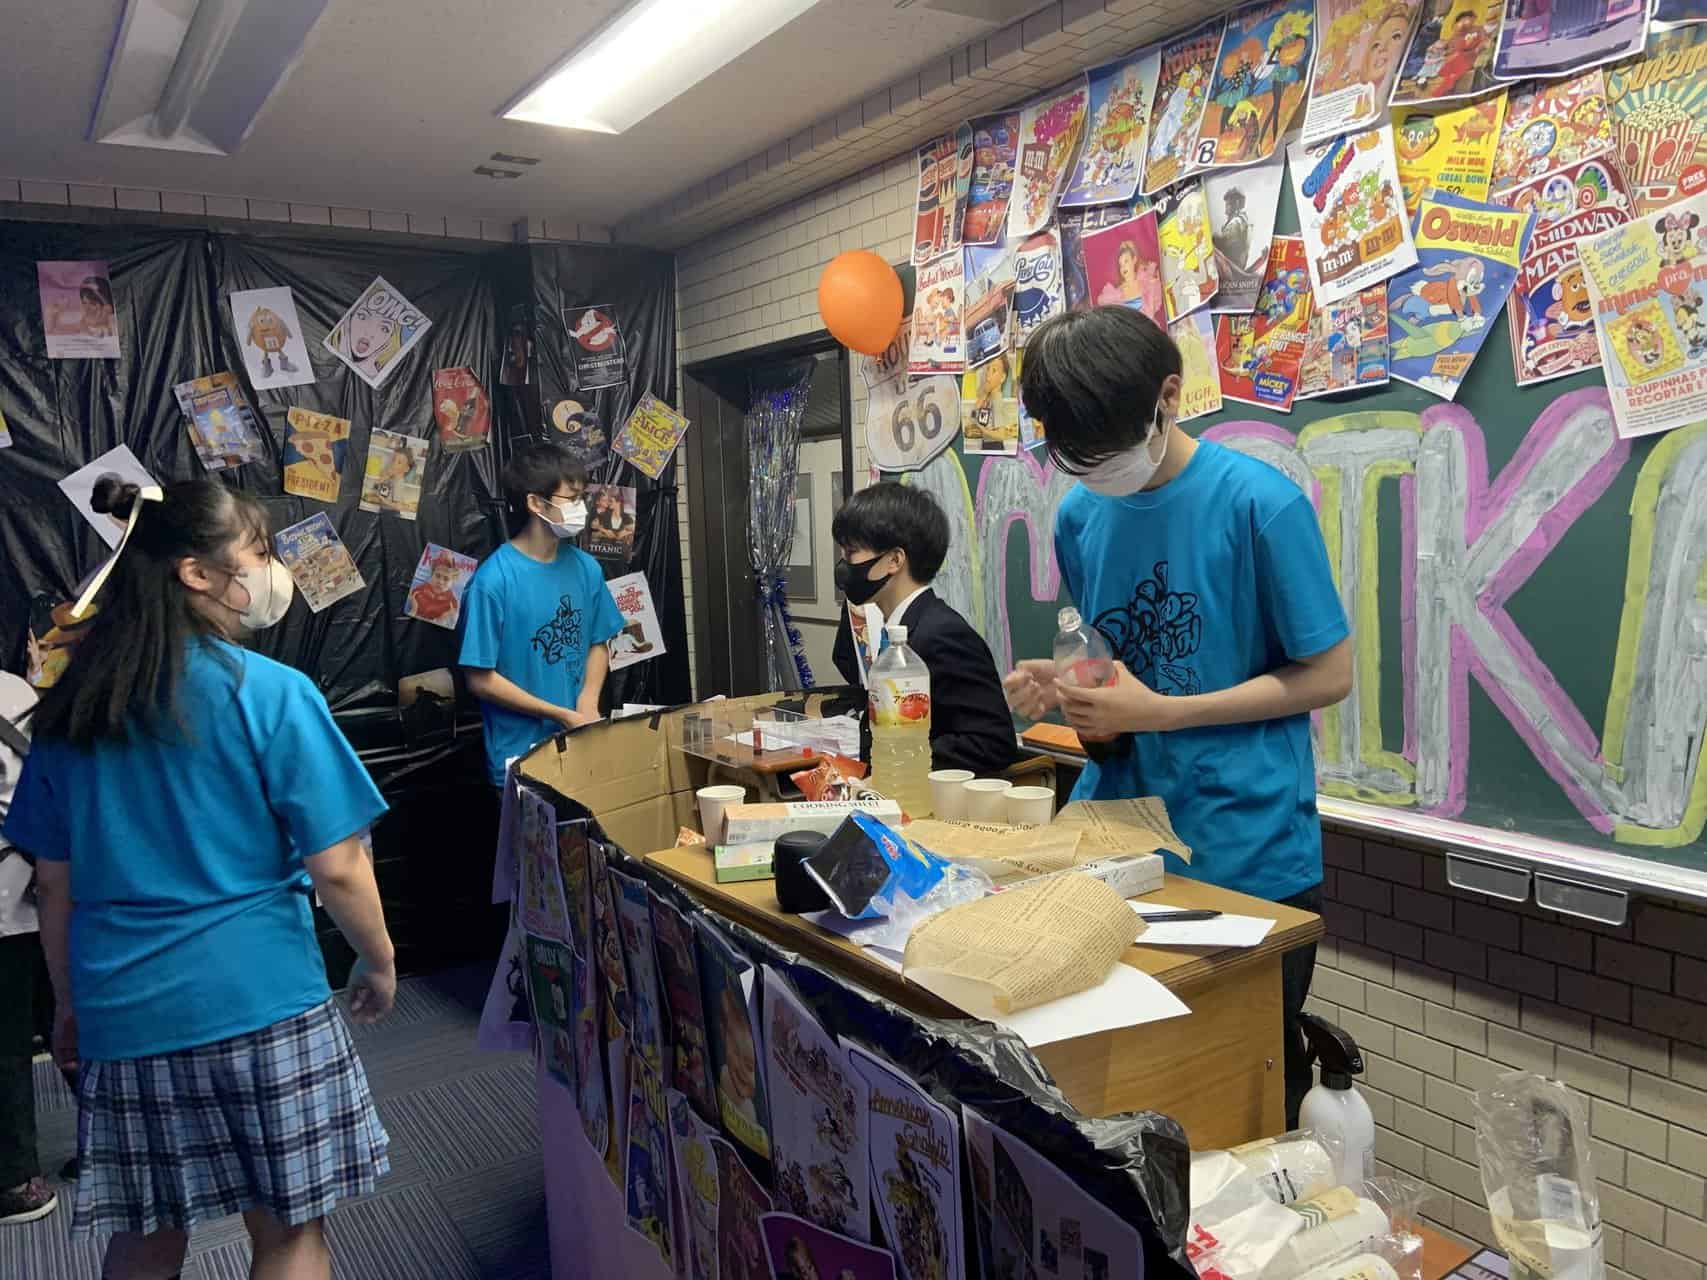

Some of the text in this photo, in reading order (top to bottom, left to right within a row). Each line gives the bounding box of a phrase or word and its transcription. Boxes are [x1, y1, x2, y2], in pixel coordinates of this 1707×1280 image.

[1603, 44, 1707, 104] Cinem
[1422, 206, 1518, 248] Oswald
[1538, 211, 1622, 247] MIDWAY
[1523, 245, 1578, 290] MAN
[1626, 371, 1696, 397] ROUPINHAS
[1629, 383, 1694, 407] RECORTAR
[294, 412, 342, 435] PIZZA
[892, 385, 942, 452] 66
[590, 543, 626, 554] TITANIC
[792, 800, 848, 809] COOKING
